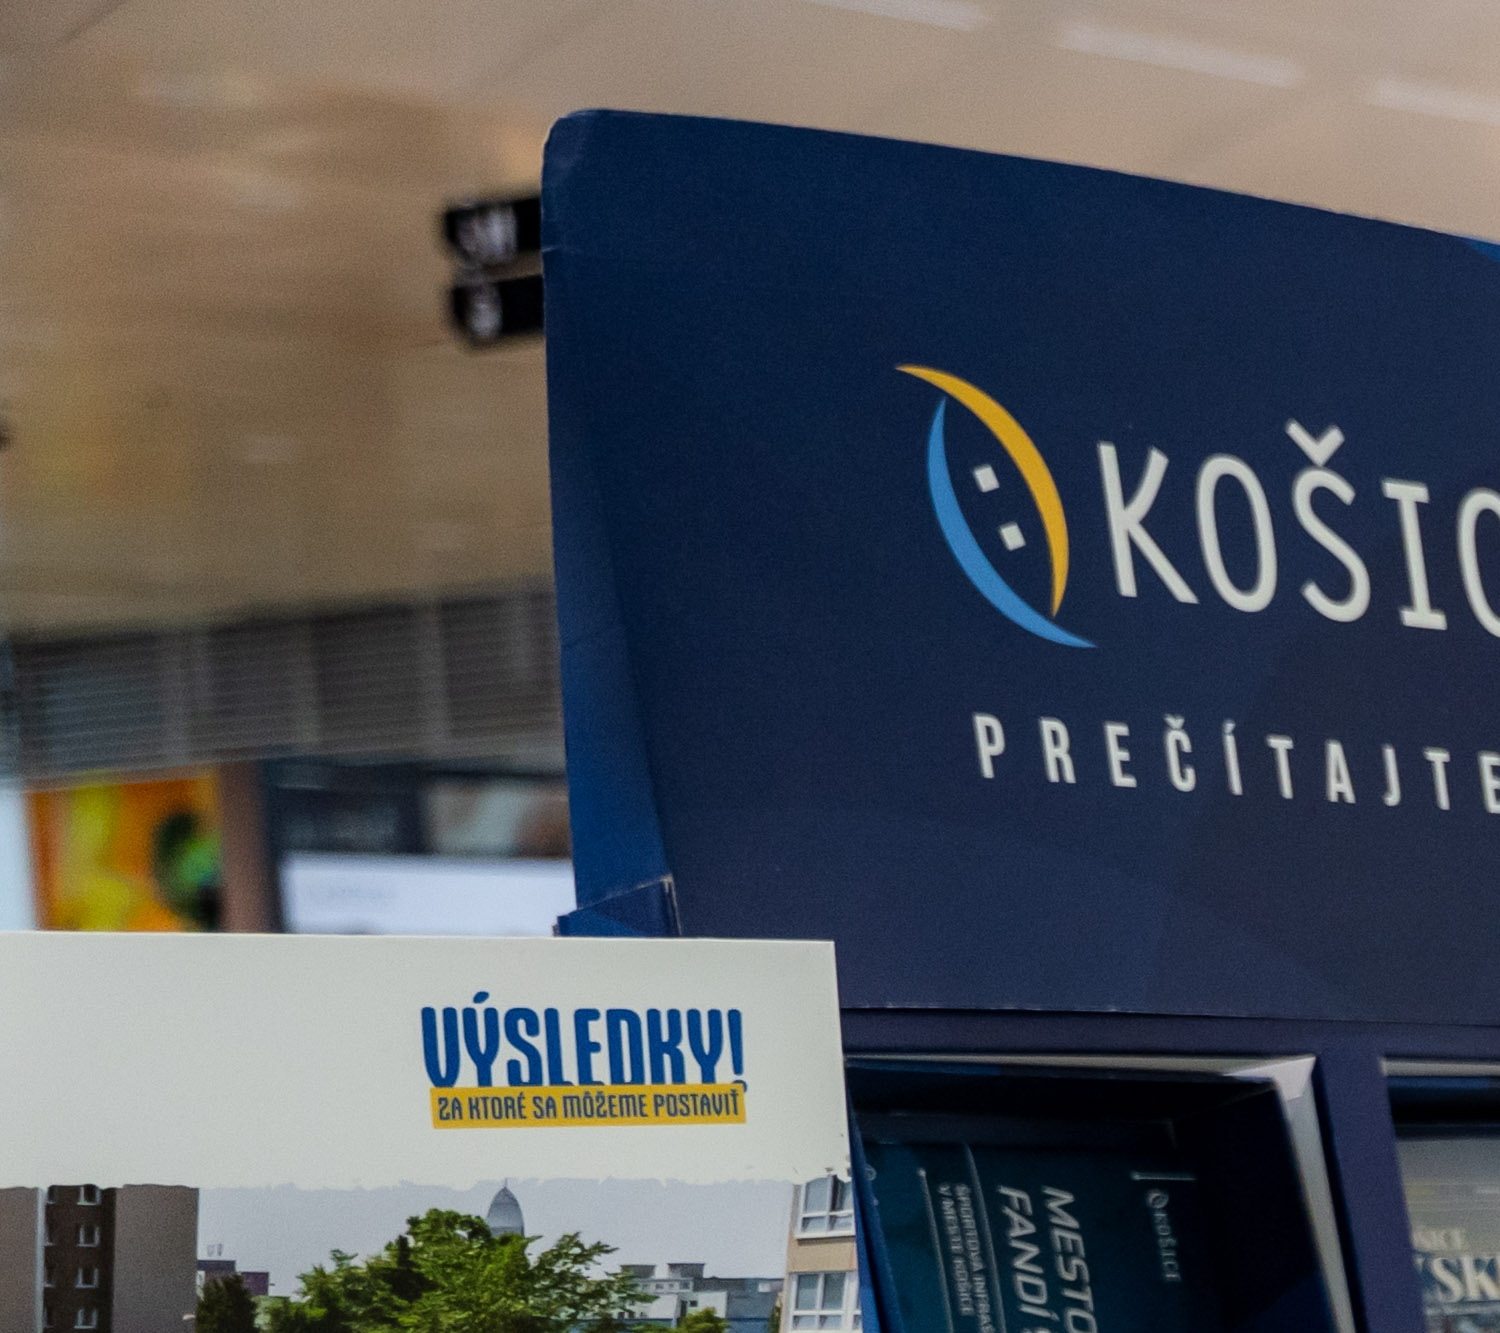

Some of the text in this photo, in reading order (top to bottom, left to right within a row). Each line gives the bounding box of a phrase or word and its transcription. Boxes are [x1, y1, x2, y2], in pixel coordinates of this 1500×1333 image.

[421, 991, 748, 1092] VÝSLEDKY!
[438, 1089, 741, 1121] ZA KTORÉ SA MÔŽEME POSTAVIŤ
[997, 1185, 1060, 1322] FANDÍ
